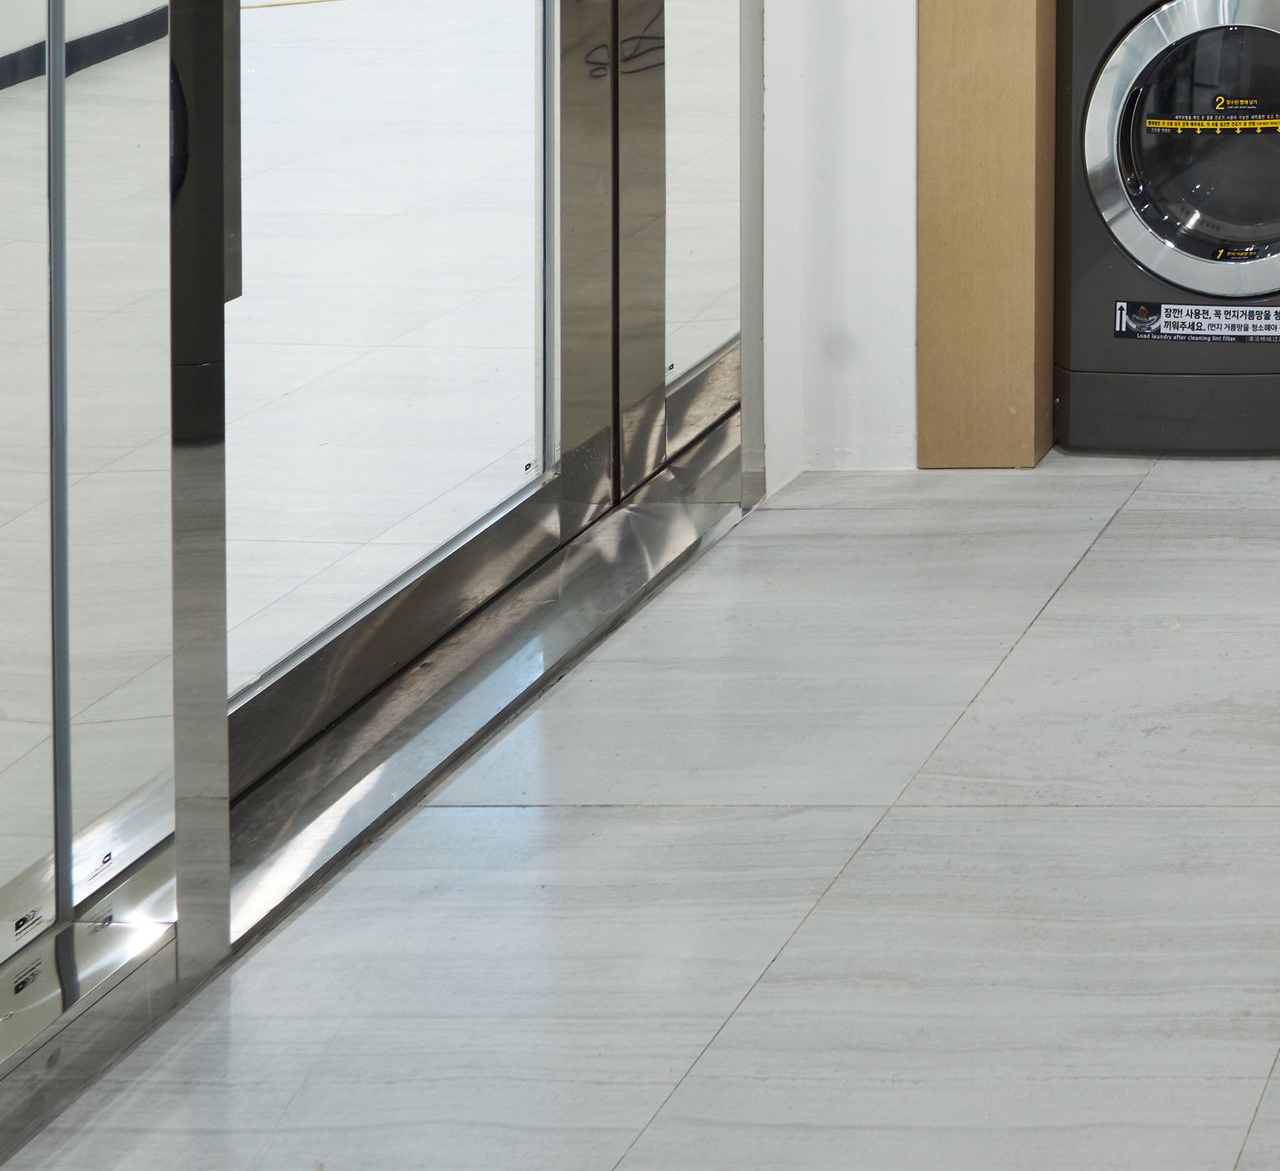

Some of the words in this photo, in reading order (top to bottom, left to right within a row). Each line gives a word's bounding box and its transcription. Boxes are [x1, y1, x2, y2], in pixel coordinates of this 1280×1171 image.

[1216, 96, 1225, 110] 2
[1164, 308, 1183, 319] 잠깐!
[1213, 309, 1222, 320] 꼭
[1224, 310, 1271, 321] 먼지거름망을
[1163, 320, 1206, 331] 끼워주세요.
[1251, 324, 1278, 332] 청소해야
